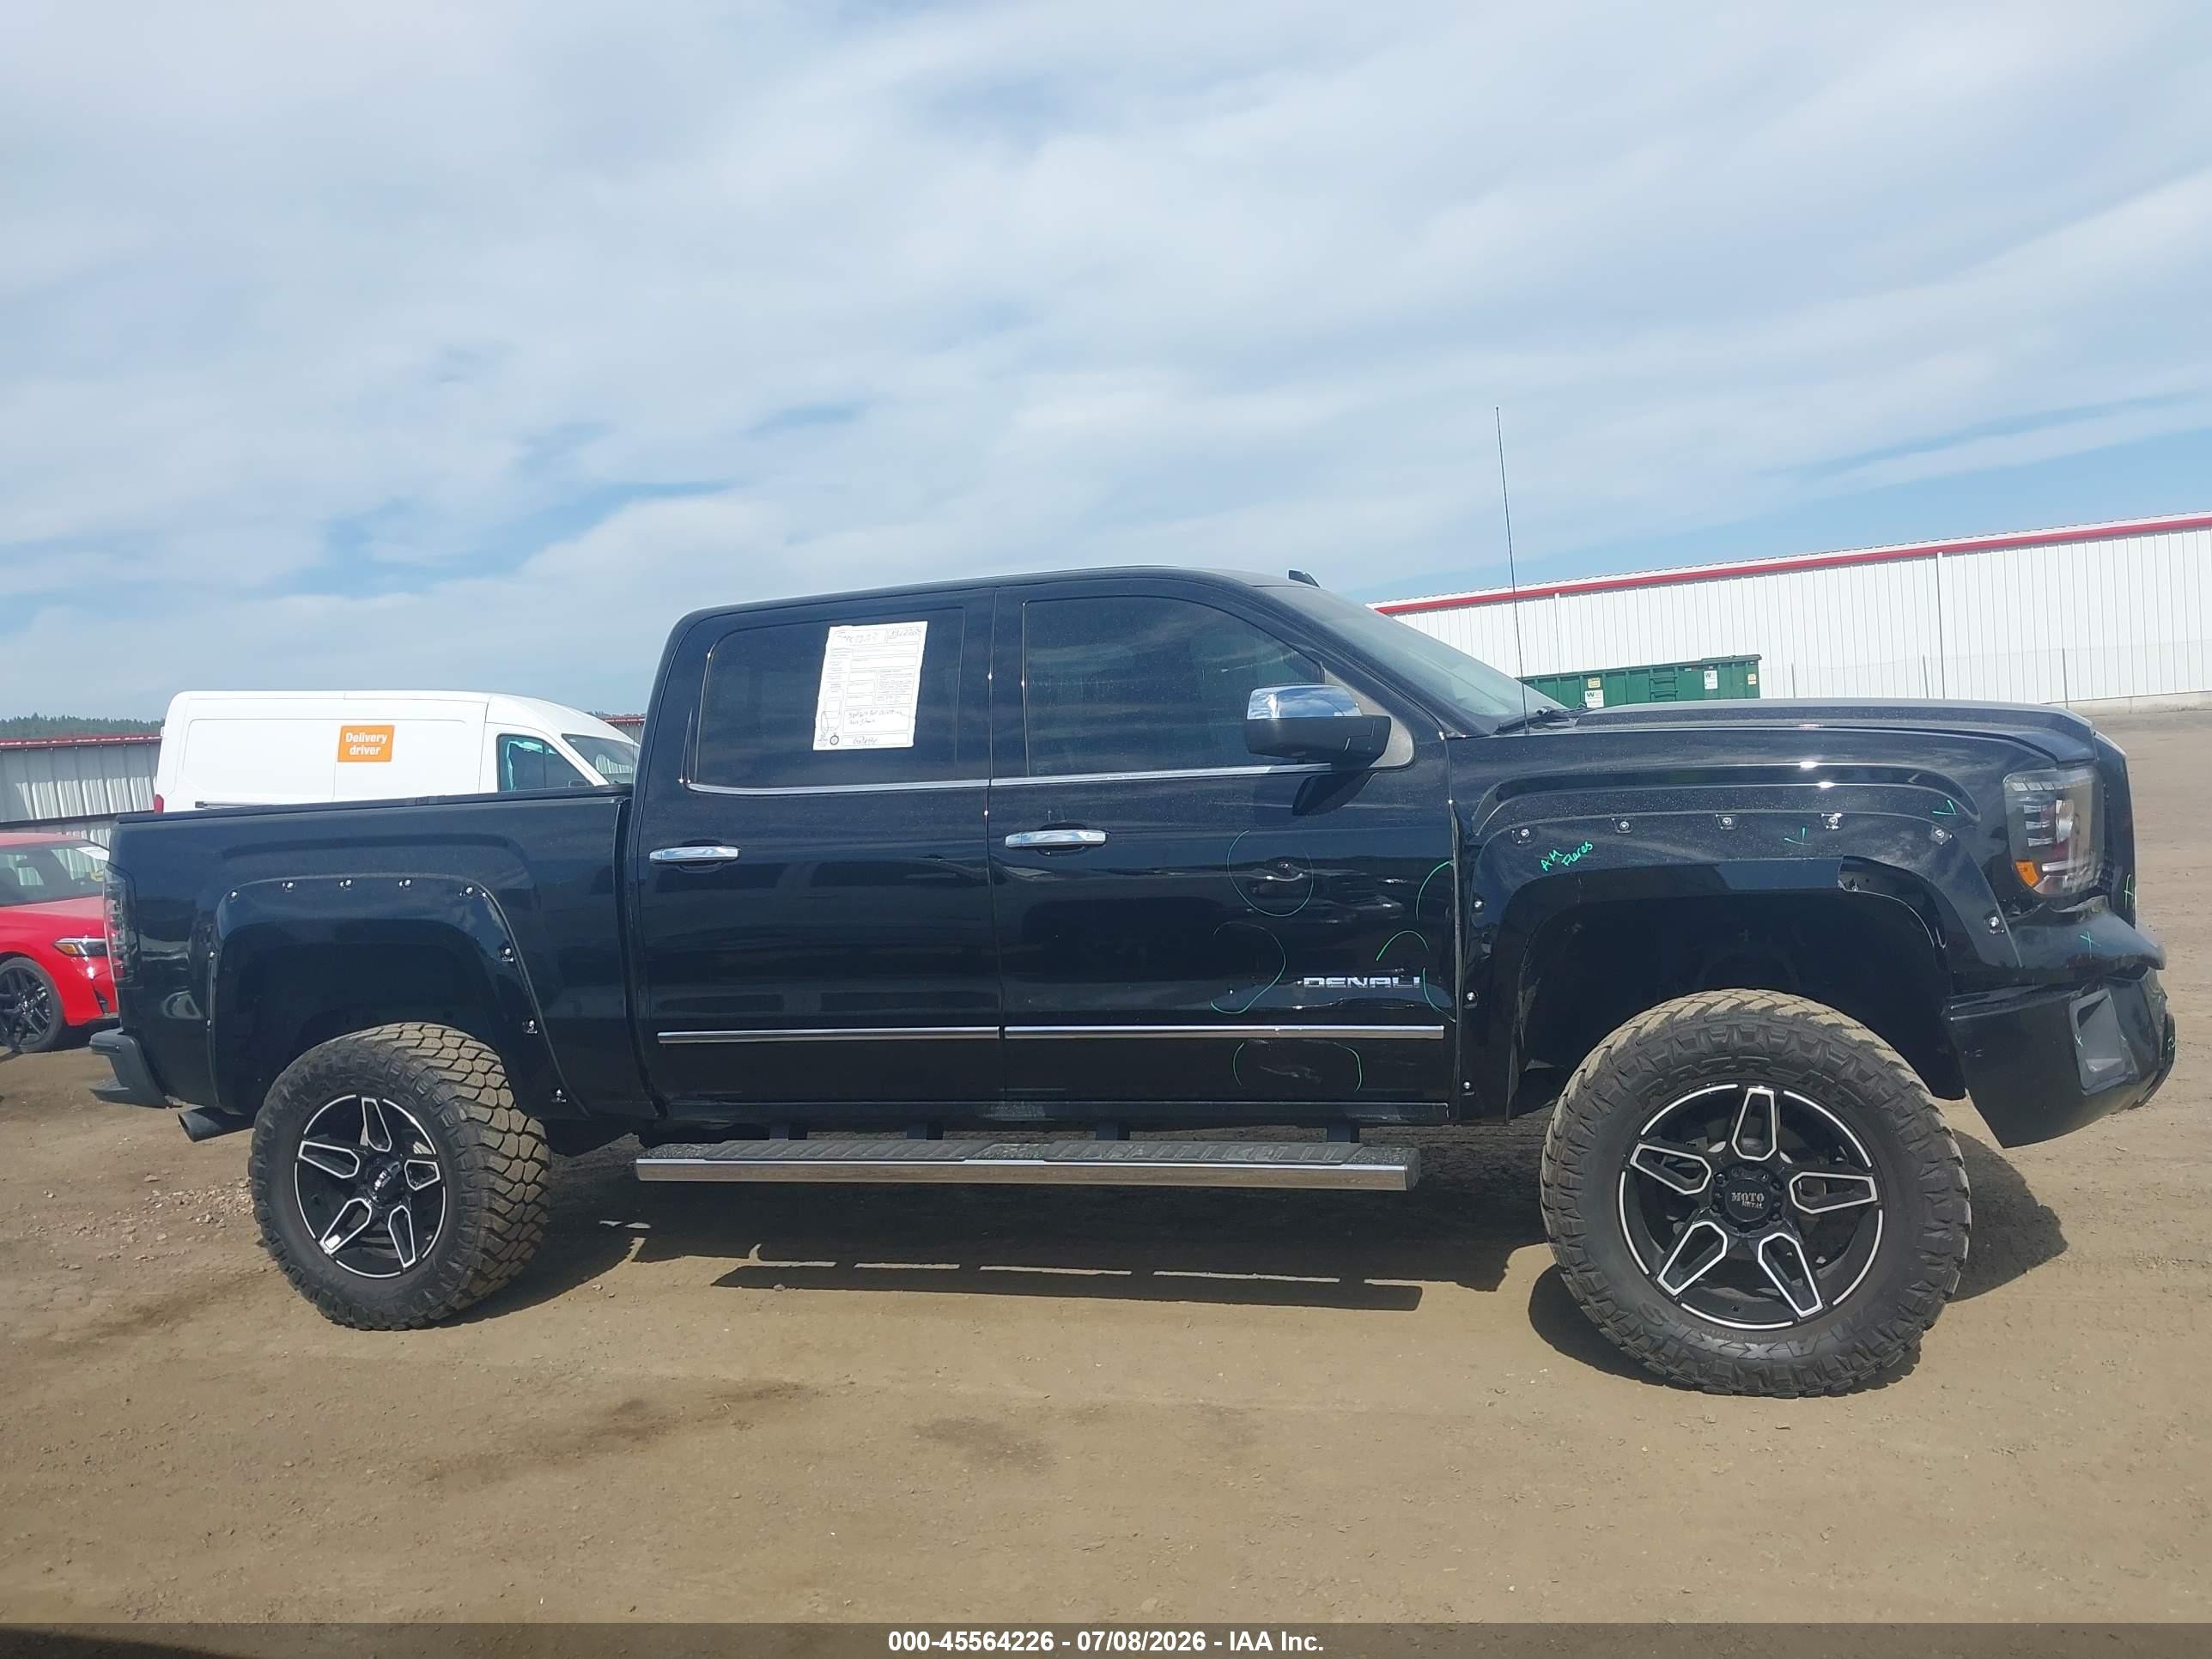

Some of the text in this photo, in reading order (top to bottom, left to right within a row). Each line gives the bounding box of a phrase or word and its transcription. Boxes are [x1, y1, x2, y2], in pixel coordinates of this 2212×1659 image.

[345, 732, 387, 744] Delivery
[349, 744, 381, 756] driver
[1303, 976, 1421, 988] DENALI
[1730, 1191, 1765, 1202] MOTO
